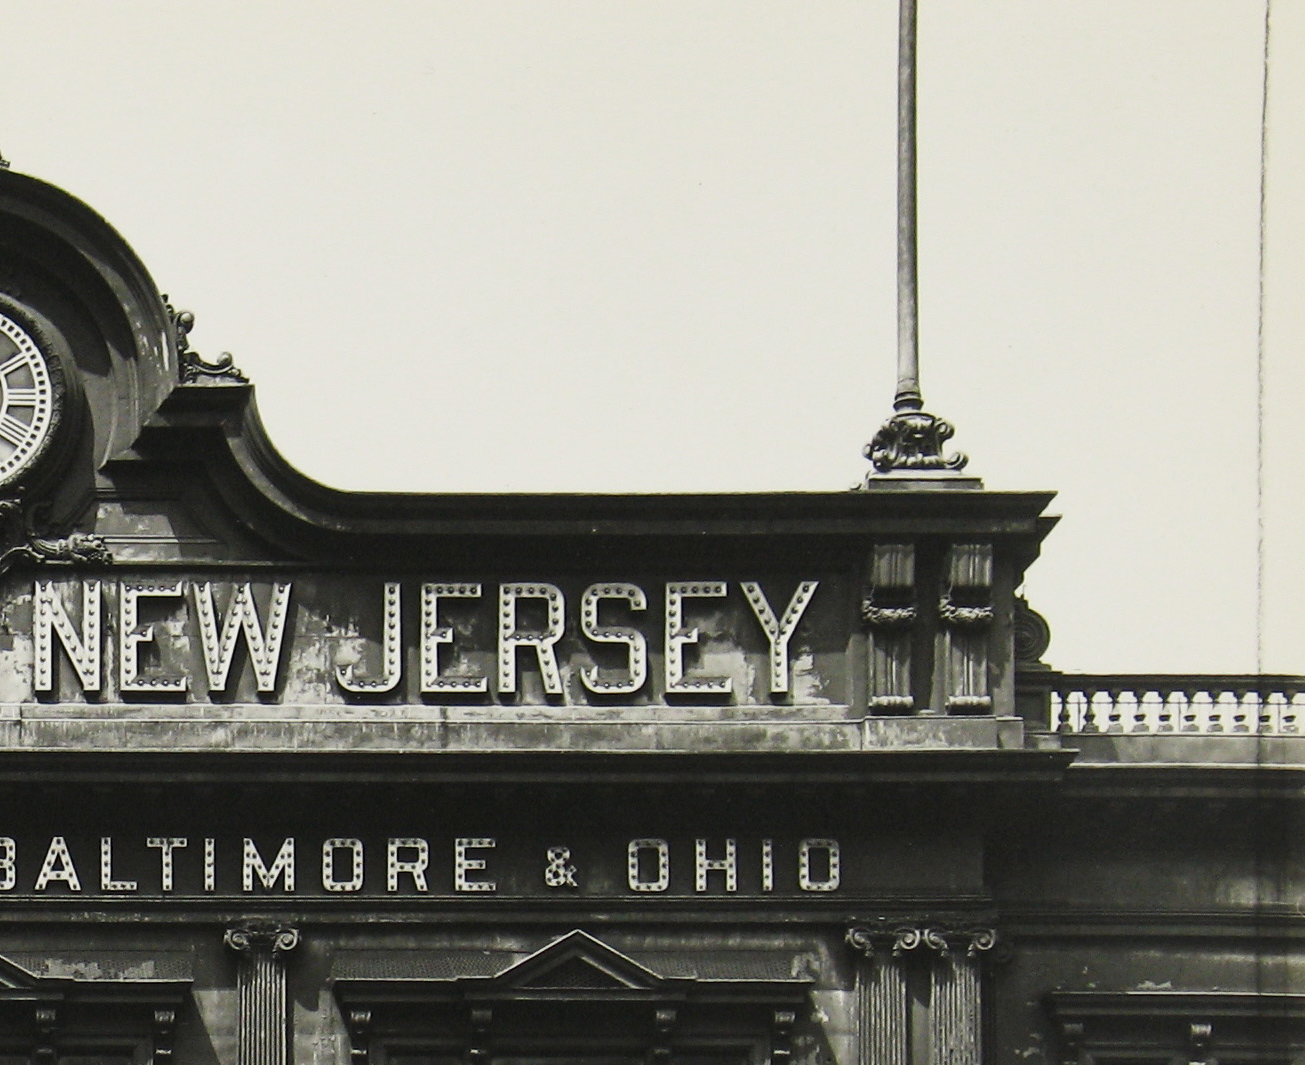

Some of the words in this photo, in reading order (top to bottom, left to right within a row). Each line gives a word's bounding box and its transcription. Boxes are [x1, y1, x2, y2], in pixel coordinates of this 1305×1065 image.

[35, 581, 291, 693] NEW
[337, 581, 819, 694] JERSEY
[544, 846, 579, 889] &
[627, 838, 840, 893] OHIO
